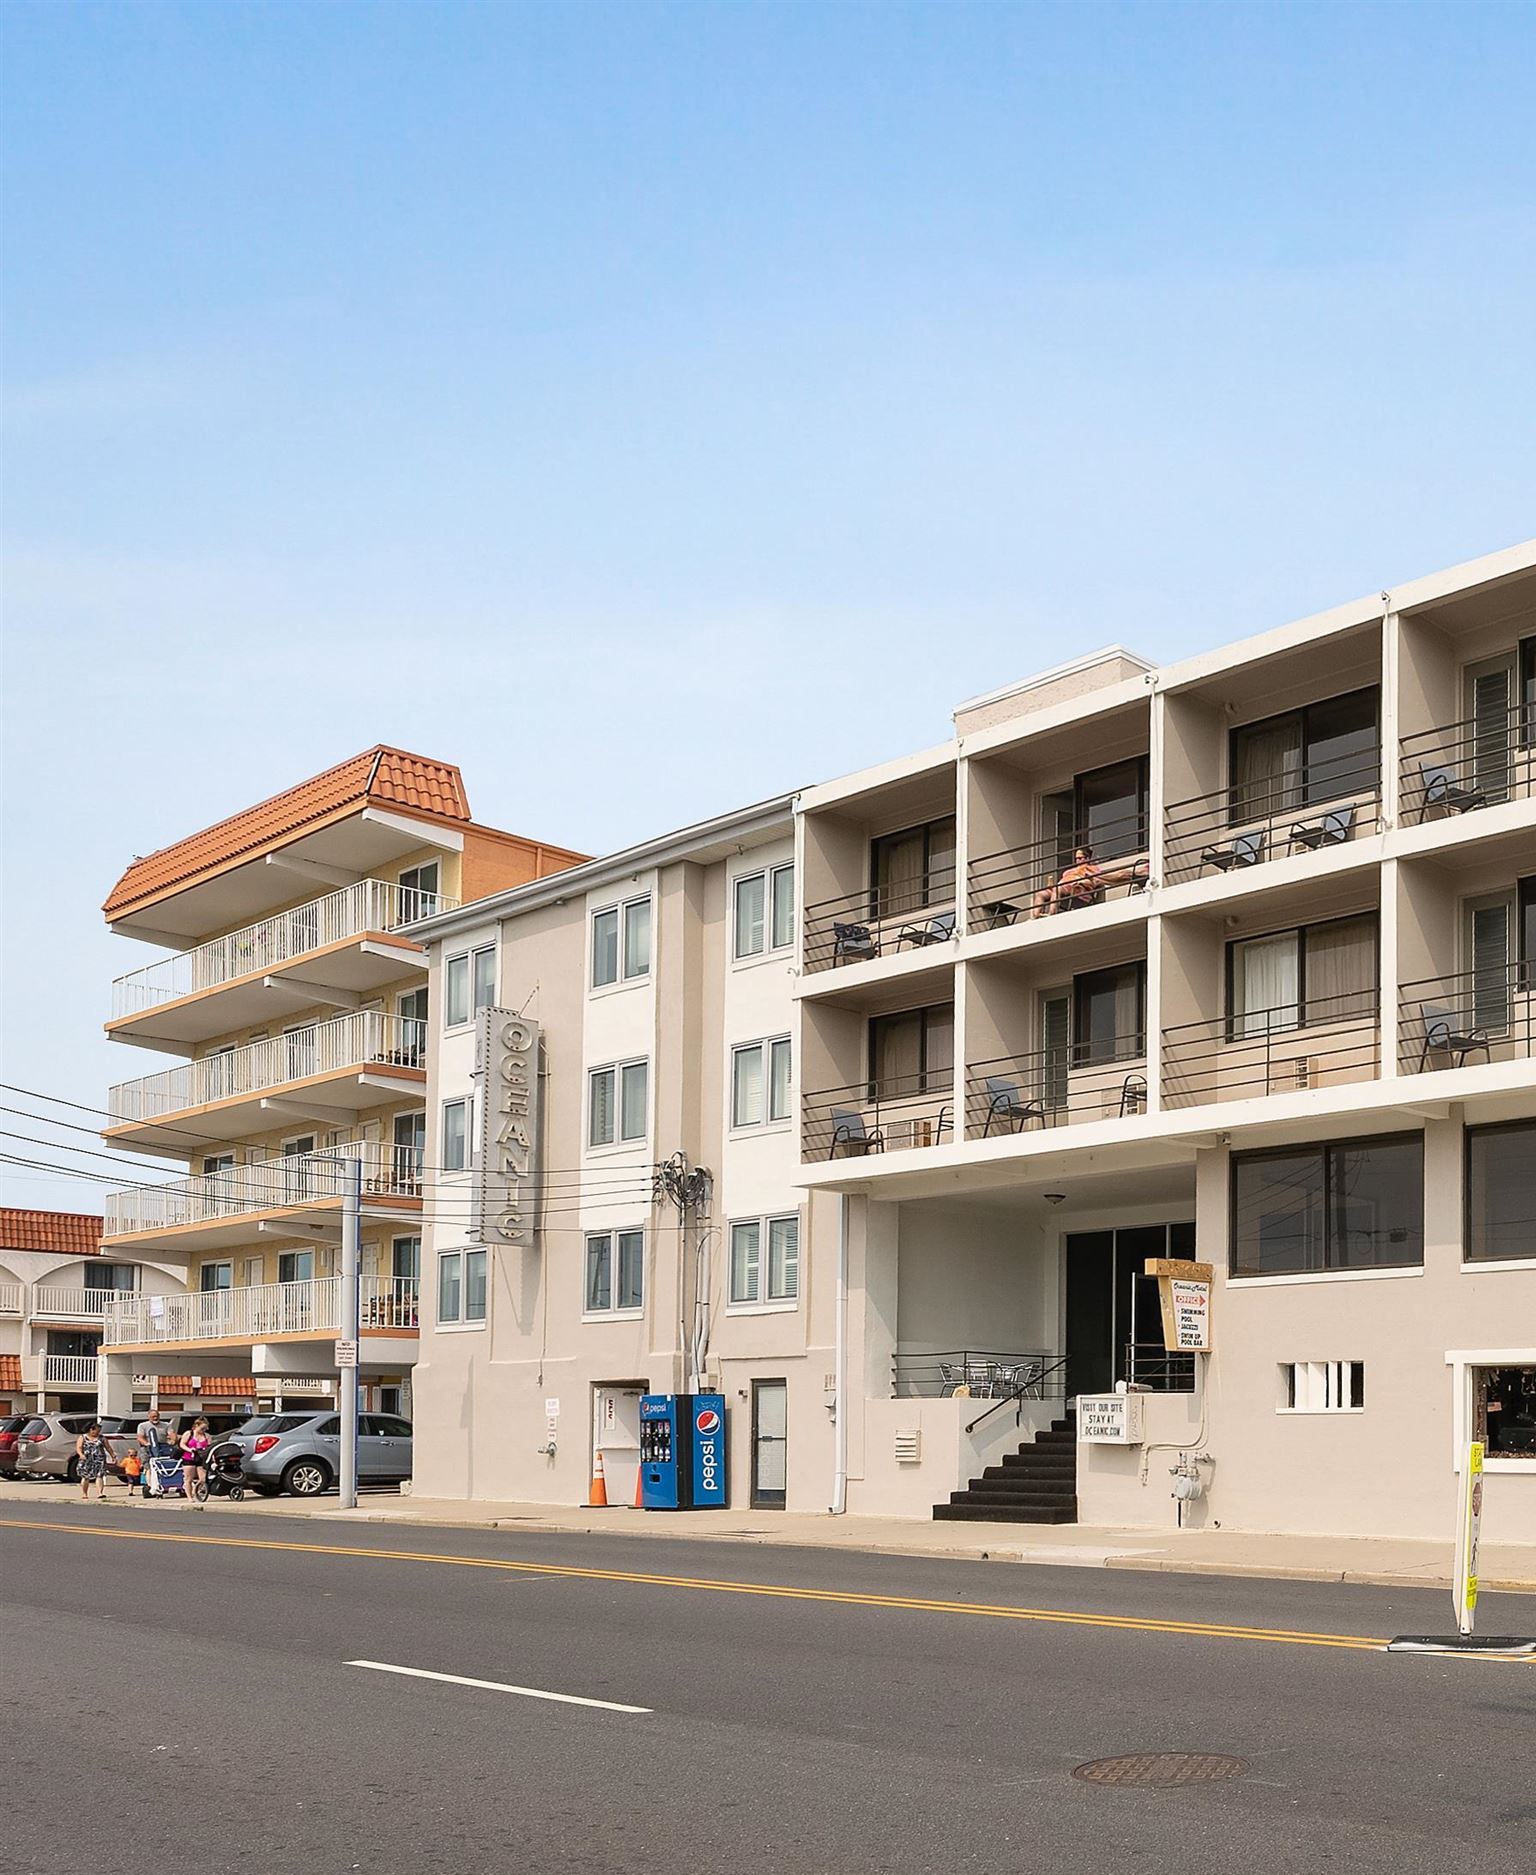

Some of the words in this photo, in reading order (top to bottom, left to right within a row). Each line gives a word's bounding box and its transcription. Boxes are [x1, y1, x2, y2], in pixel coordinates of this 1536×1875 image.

[496, 1021, 533, 1239] OCEANIC
[1177, 1296, 1201, 1305] OFFICE
[1180, 1307, 1206, 1316] SWIMMING
[650, 1403, 667, 1414] pepsi
[1082, 1403, 1096, 1412] VISIT
[1098, 1403, 1109, 1412] OUR
[1110, 1404, 1123, 1413] SITE
[1088, 1414, 1106, 1424] STAY
[1107, 1415, 1115, 1424] AT
[700, 1438, 718, 1490] pepsi
